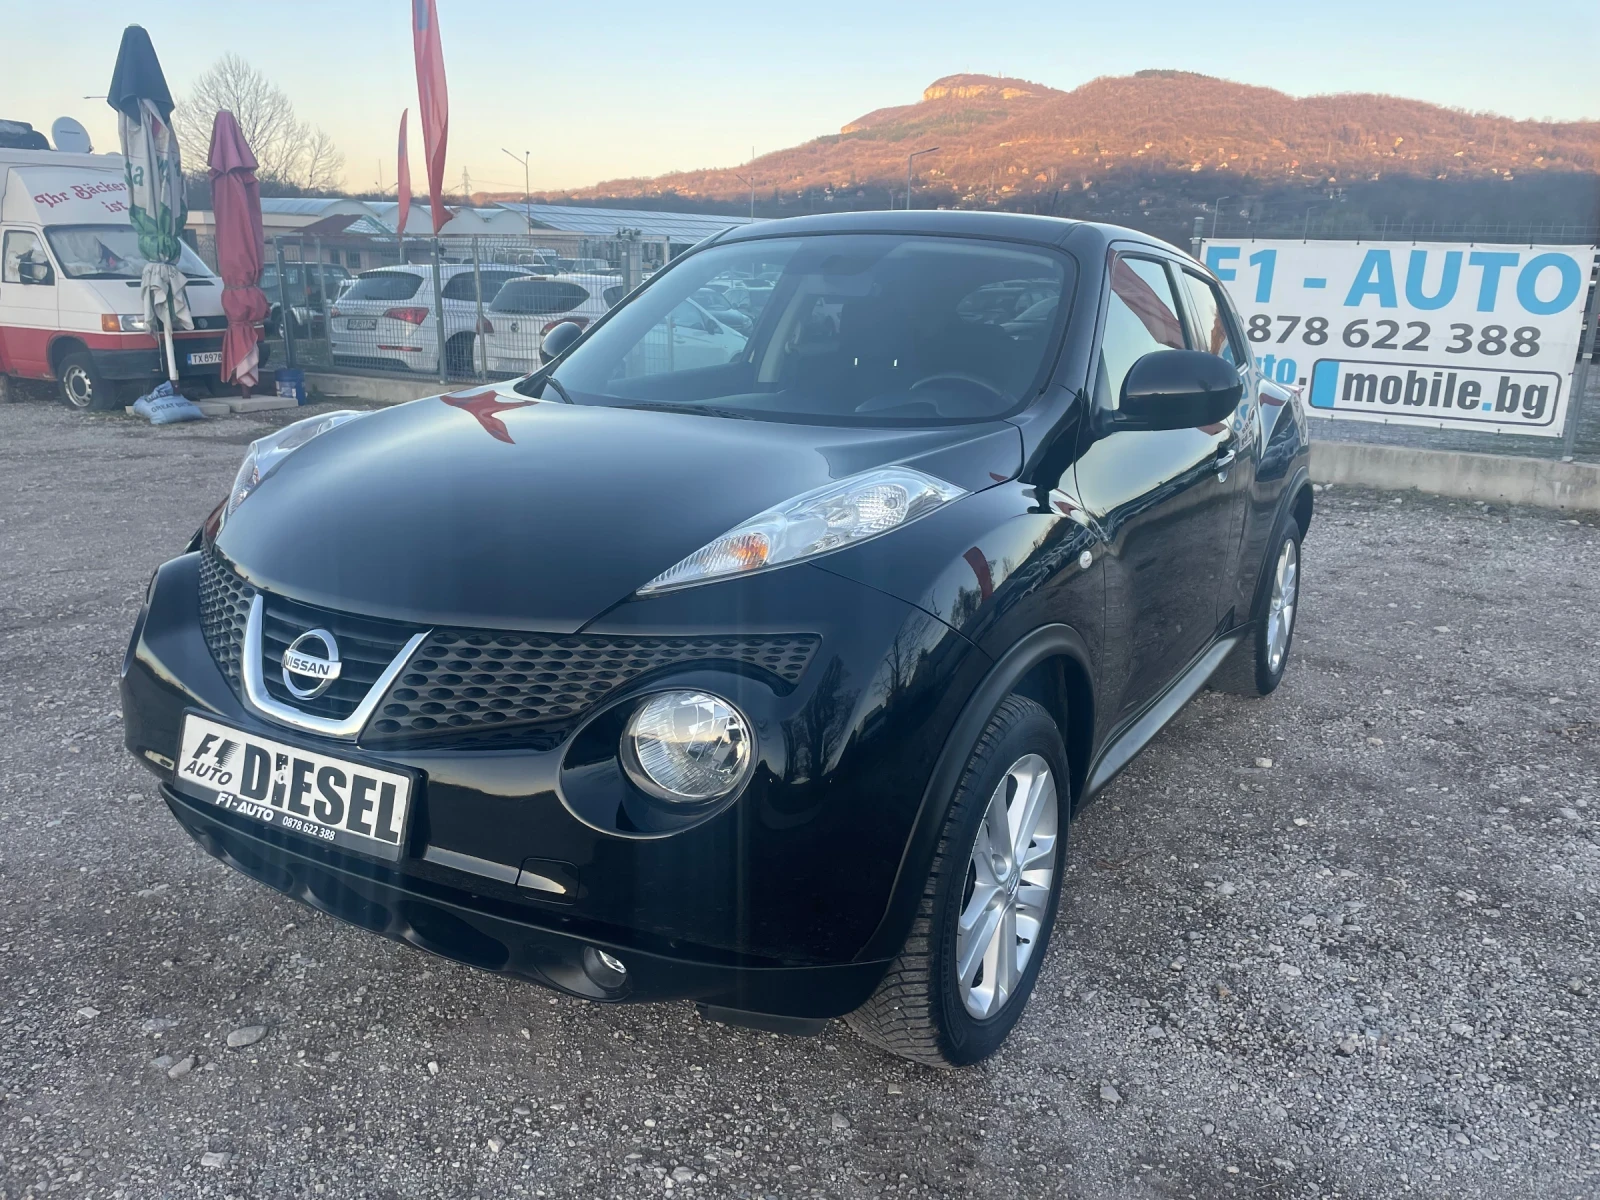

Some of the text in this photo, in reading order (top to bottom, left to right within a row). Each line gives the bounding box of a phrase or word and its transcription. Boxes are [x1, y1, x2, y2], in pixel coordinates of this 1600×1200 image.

[34, 181, 126, 208] Ihr Bäcker
[102, 201, 128, 213] ist
[1205, 246, 1582, 315] F1 - AUTO
[1241, 313, 1542, 358] 878 622 388
[193, 354, 203, 363] TX
[1342, 370, 1549, 420] mobile.bg
[285, 654, 330, 676] NISSAN
[192, 733, 240, 768] F1
[184, 760, 233, 785] AUTO
[215, 792, 274, 822] F1-AUTO
[282, 815, 336, 841] 0878 622 388
